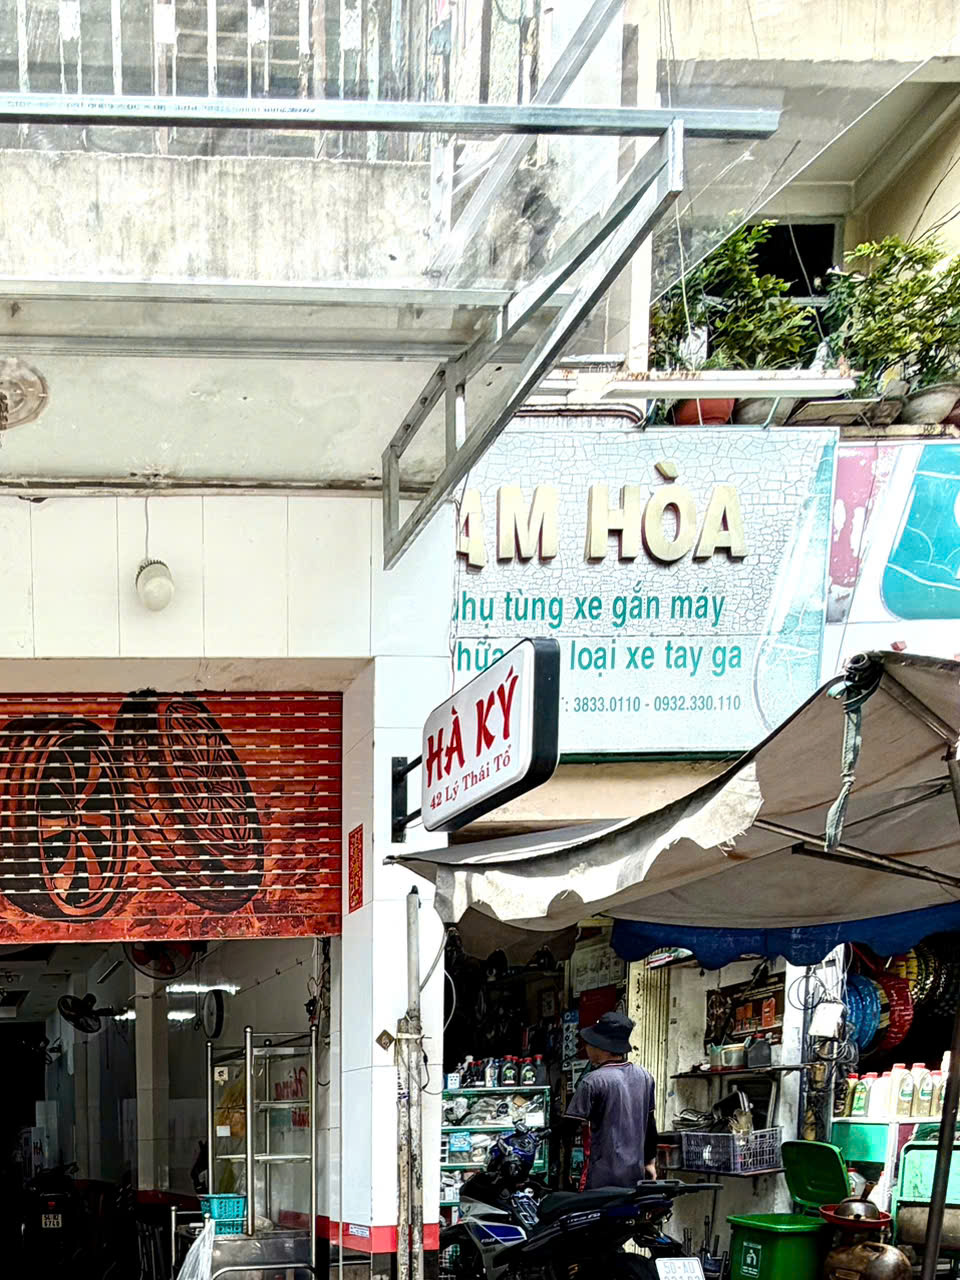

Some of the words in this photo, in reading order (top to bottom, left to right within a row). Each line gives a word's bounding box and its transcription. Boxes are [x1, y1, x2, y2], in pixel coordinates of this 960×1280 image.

[585, 461, 749, 567] HÒA
[453, 590, 494, 629] hụ
[504, 588, 563, 629] tùng
[574, 594, 602, 620] xe
[612, 580, 660, 628] gắn
[670, 586, 726, 627] máy
[570, 639, 617, 678] loại
[625, 645, 655, 670] xe
[664, 640, 703, 677] tay
[711, 644, 742, 677] ga
[426, 705, 465, 788] HÀ
[475, 664, 519, 757] KÝ
[573, 696, 641, 712] 3833.0110
[653, 695, 740, 711] 0932.330.110
[430, 791, 442, 810] 42
[445, 777, 460, 802] Lý
[462, 766, 490, 792] Thái
[493, 743, 512, 773] Tổ
